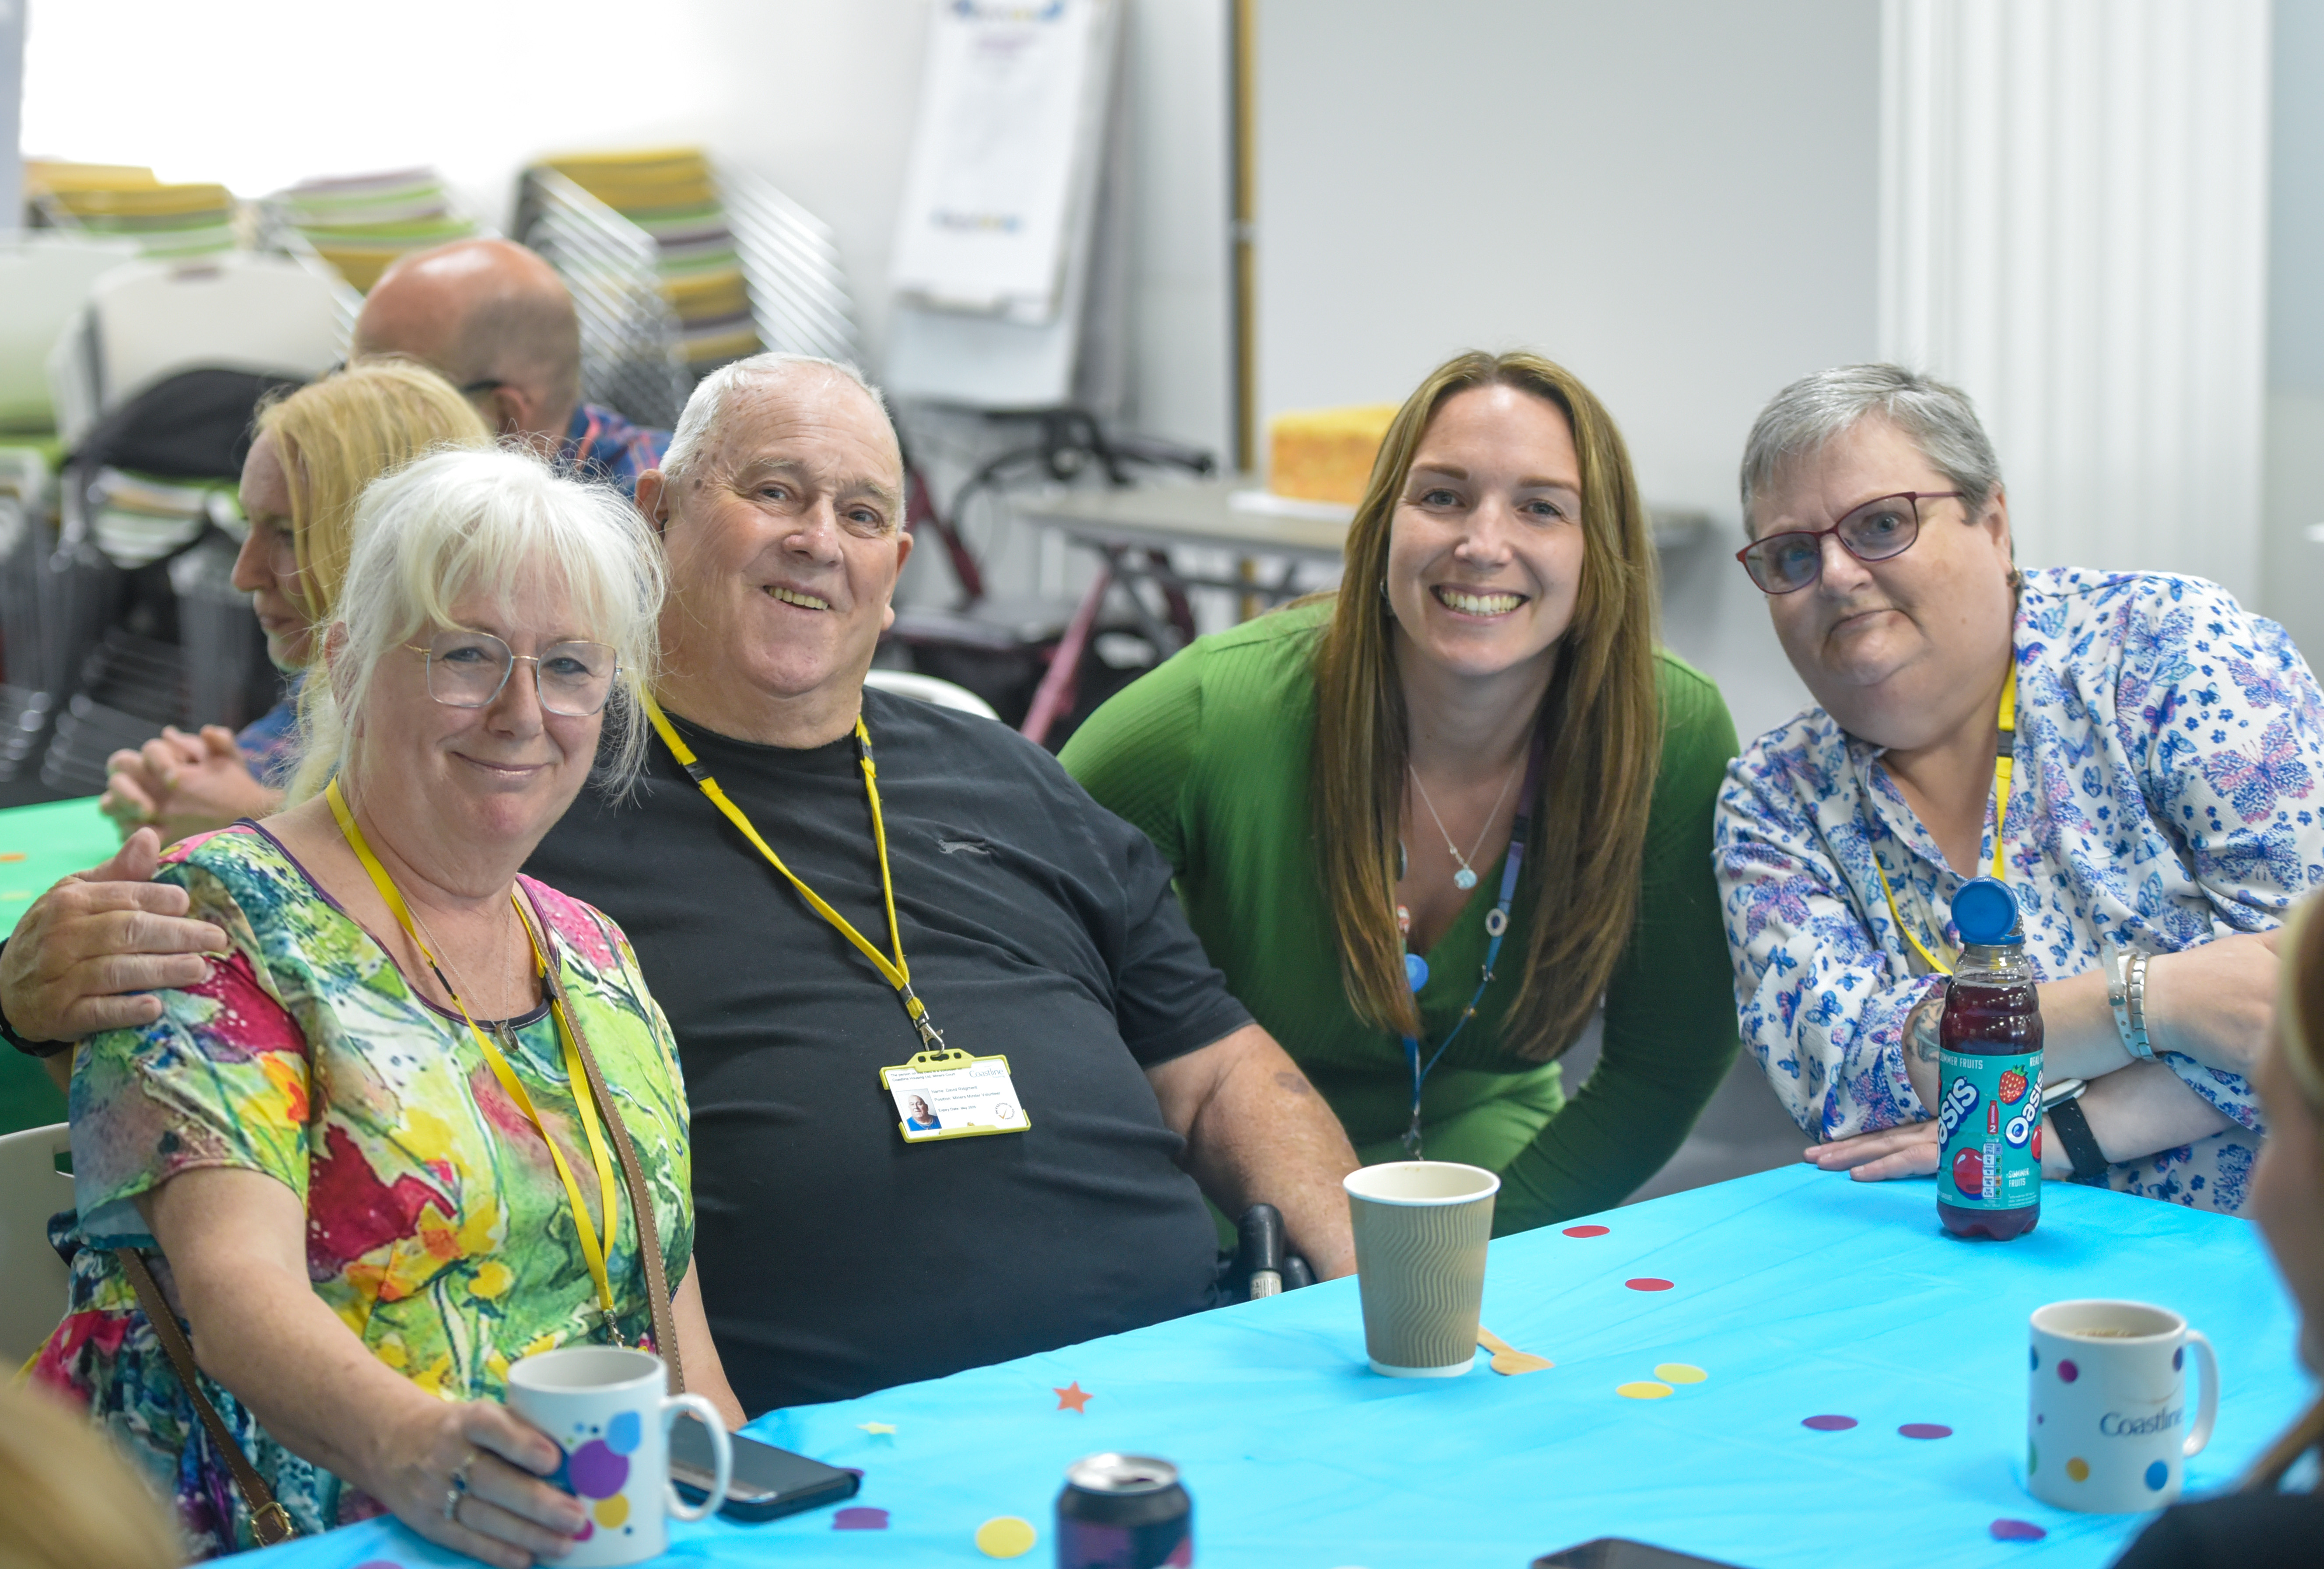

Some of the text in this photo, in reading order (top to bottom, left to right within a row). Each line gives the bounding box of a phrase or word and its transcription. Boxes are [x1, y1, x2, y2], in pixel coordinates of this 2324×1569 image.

[1940, 1052, 1983, 1070] SUMMER FRUITS
[2029, 1055, 2040, 1067] REAL
[969, 1068, 1004, 1078] Coastline
[1990, 1124, 1996, 1133] 2
[2008, 1168, 2029, 1178] SUMMER
[2008, 1177, 2026, 1187] FRUITS
